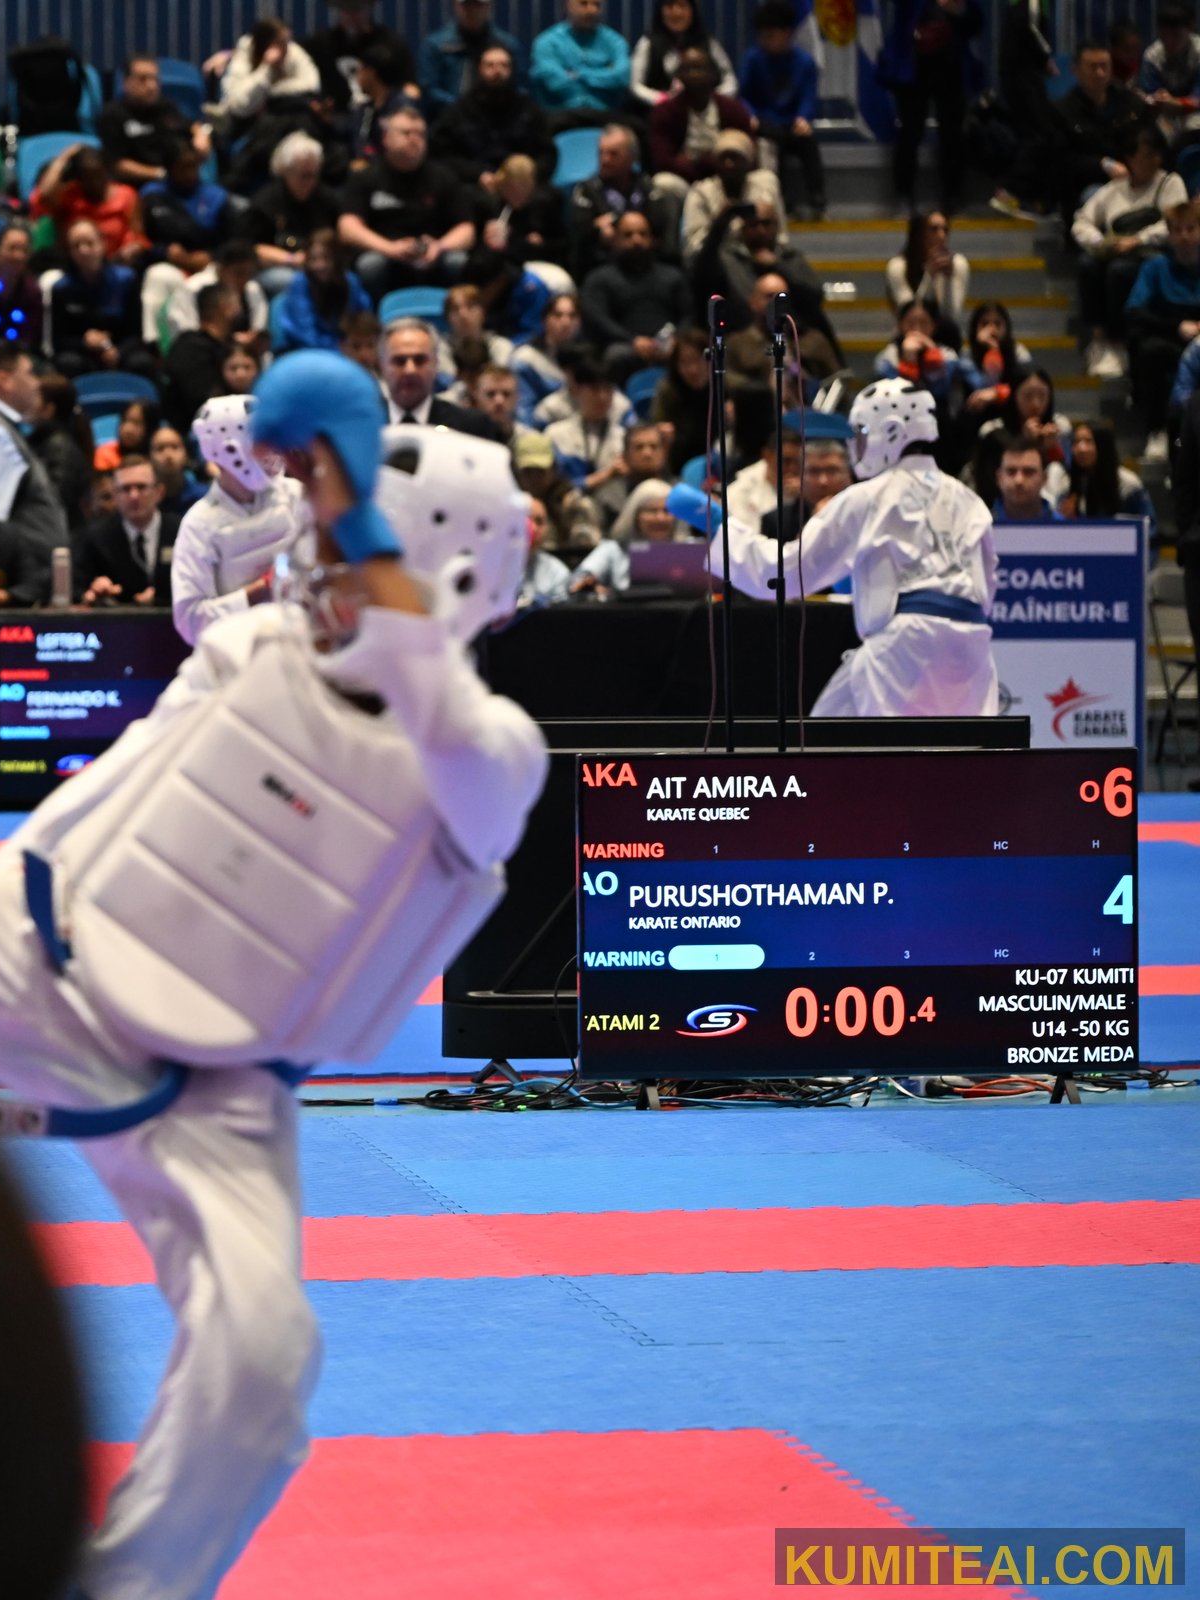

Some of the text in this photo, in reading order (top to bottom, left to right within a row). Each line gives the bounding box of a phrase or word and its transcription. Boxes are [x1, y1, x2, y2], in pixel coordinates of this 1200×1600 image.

[997, 568, 1085, 590] COACH
[1073, 710, 1126, 723] KARATE
[1073, 723, 1128, 737] CANADA
[646, 775, 808, 800] AIT AMIRA A.
[646, 807, 750, 821] KARATE QUEBEC
[583, 842, 665, 859] WARNING
[713, 844, 719, 854] 1
[808, 843, 815, 853] 2
[903, 842, 910, 851] 3
[993, 840, 1009, 850] HC
[1092, 839, 1100, 849] H
[629, 882, 894, 907] PURUSHOTHAMAN P.
[1103, 875, 1133, 924] 4
[628, 915, 741, 930] KARATE ONTARIO
[584, 951, 665, 967] WARNING
[808, 952, 816, 961] 2
[903, 950, 910, 960] 3
[993, 948, 1009, 959] HC
[1092, 947, 1101, 957] H
[1015, 968, 1134, 986] KU-07 KUMIT
[978, 993, 1127, 1013] MASCULIN/MALE
[585, 1014, 660, 1031] ATAMI 2
[1032, 1019, 1130, 1038] U14 -50 KG
[1007, 1046, 1079, 1064] BRONZE
